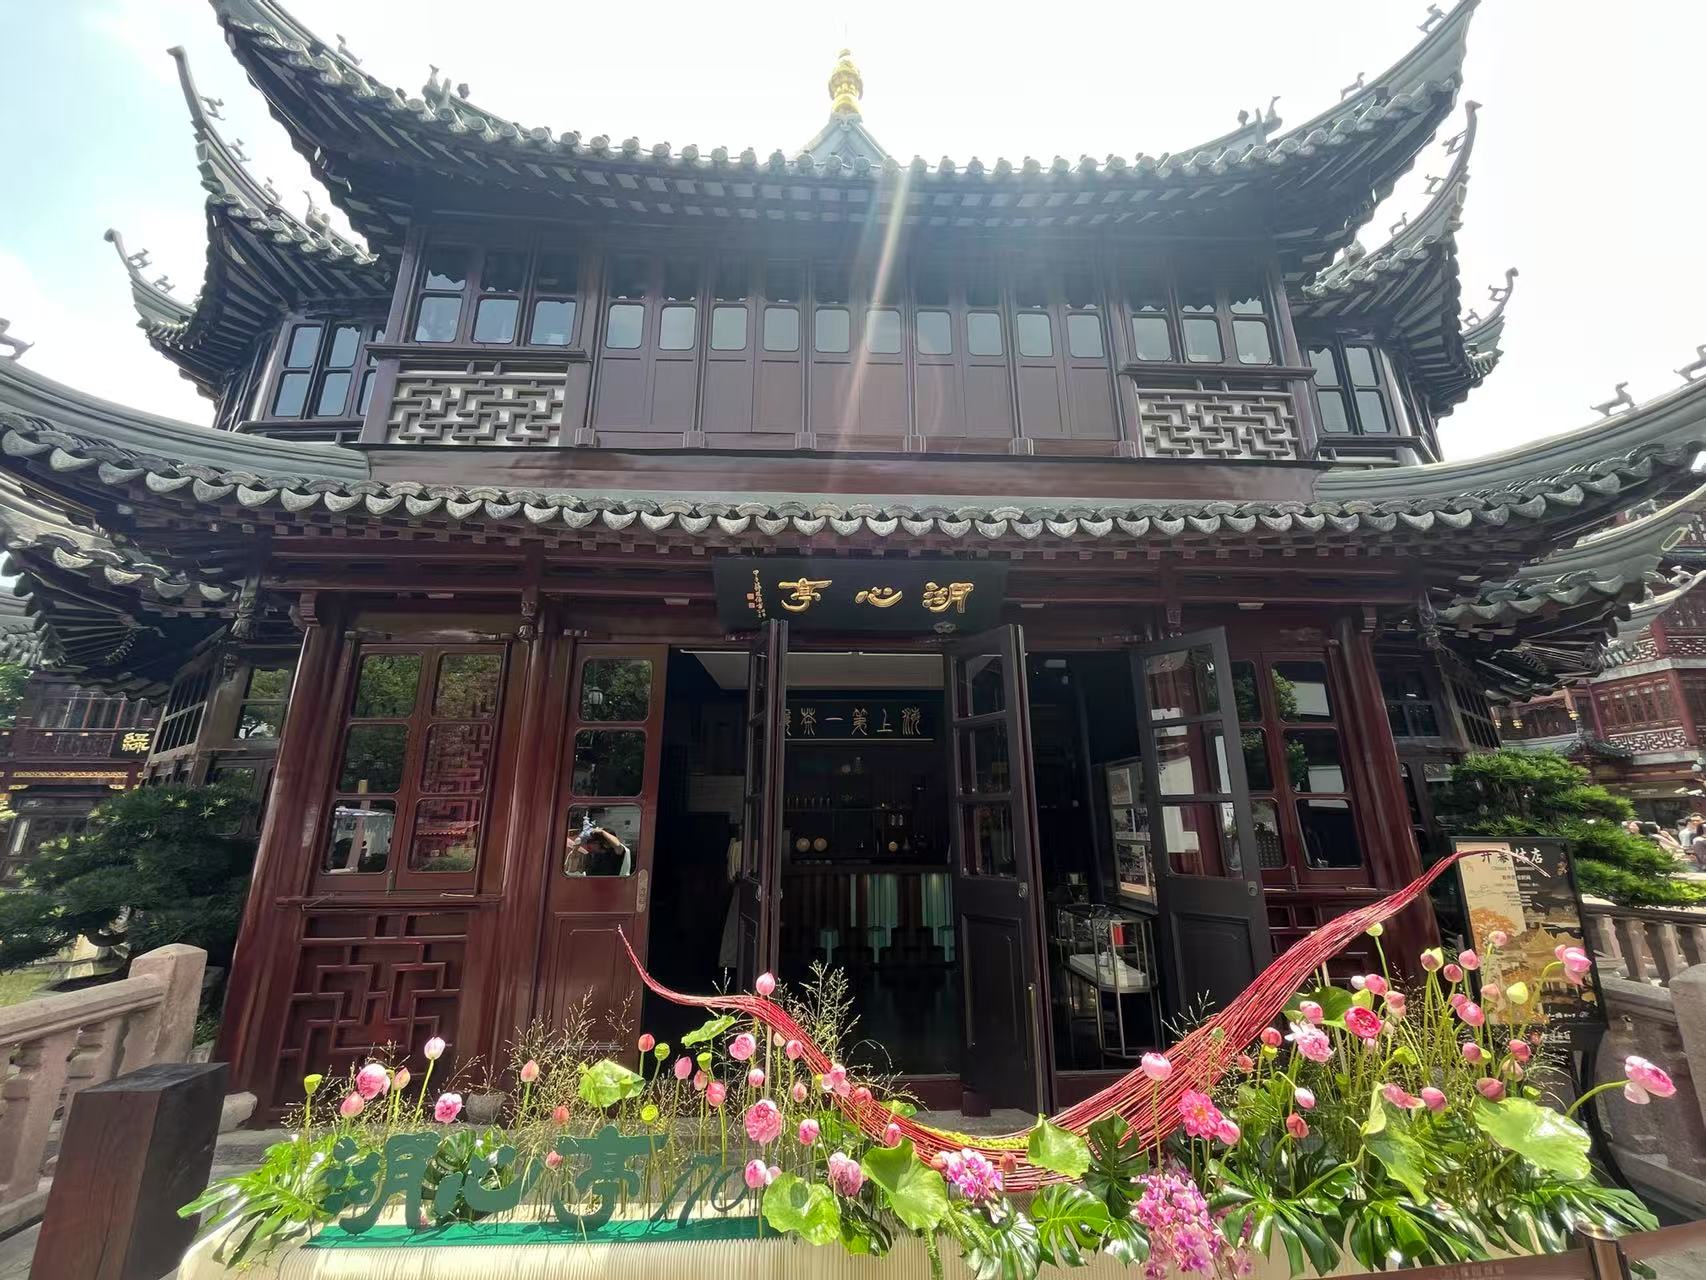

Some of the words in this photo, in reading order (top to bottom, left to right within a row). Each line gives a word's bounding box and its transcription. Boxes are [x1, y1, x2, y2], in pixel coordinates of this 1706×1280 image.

[778, 577, 975, 614] 湖心亭
[322, 1125, 669, 1235] 湖心亭
